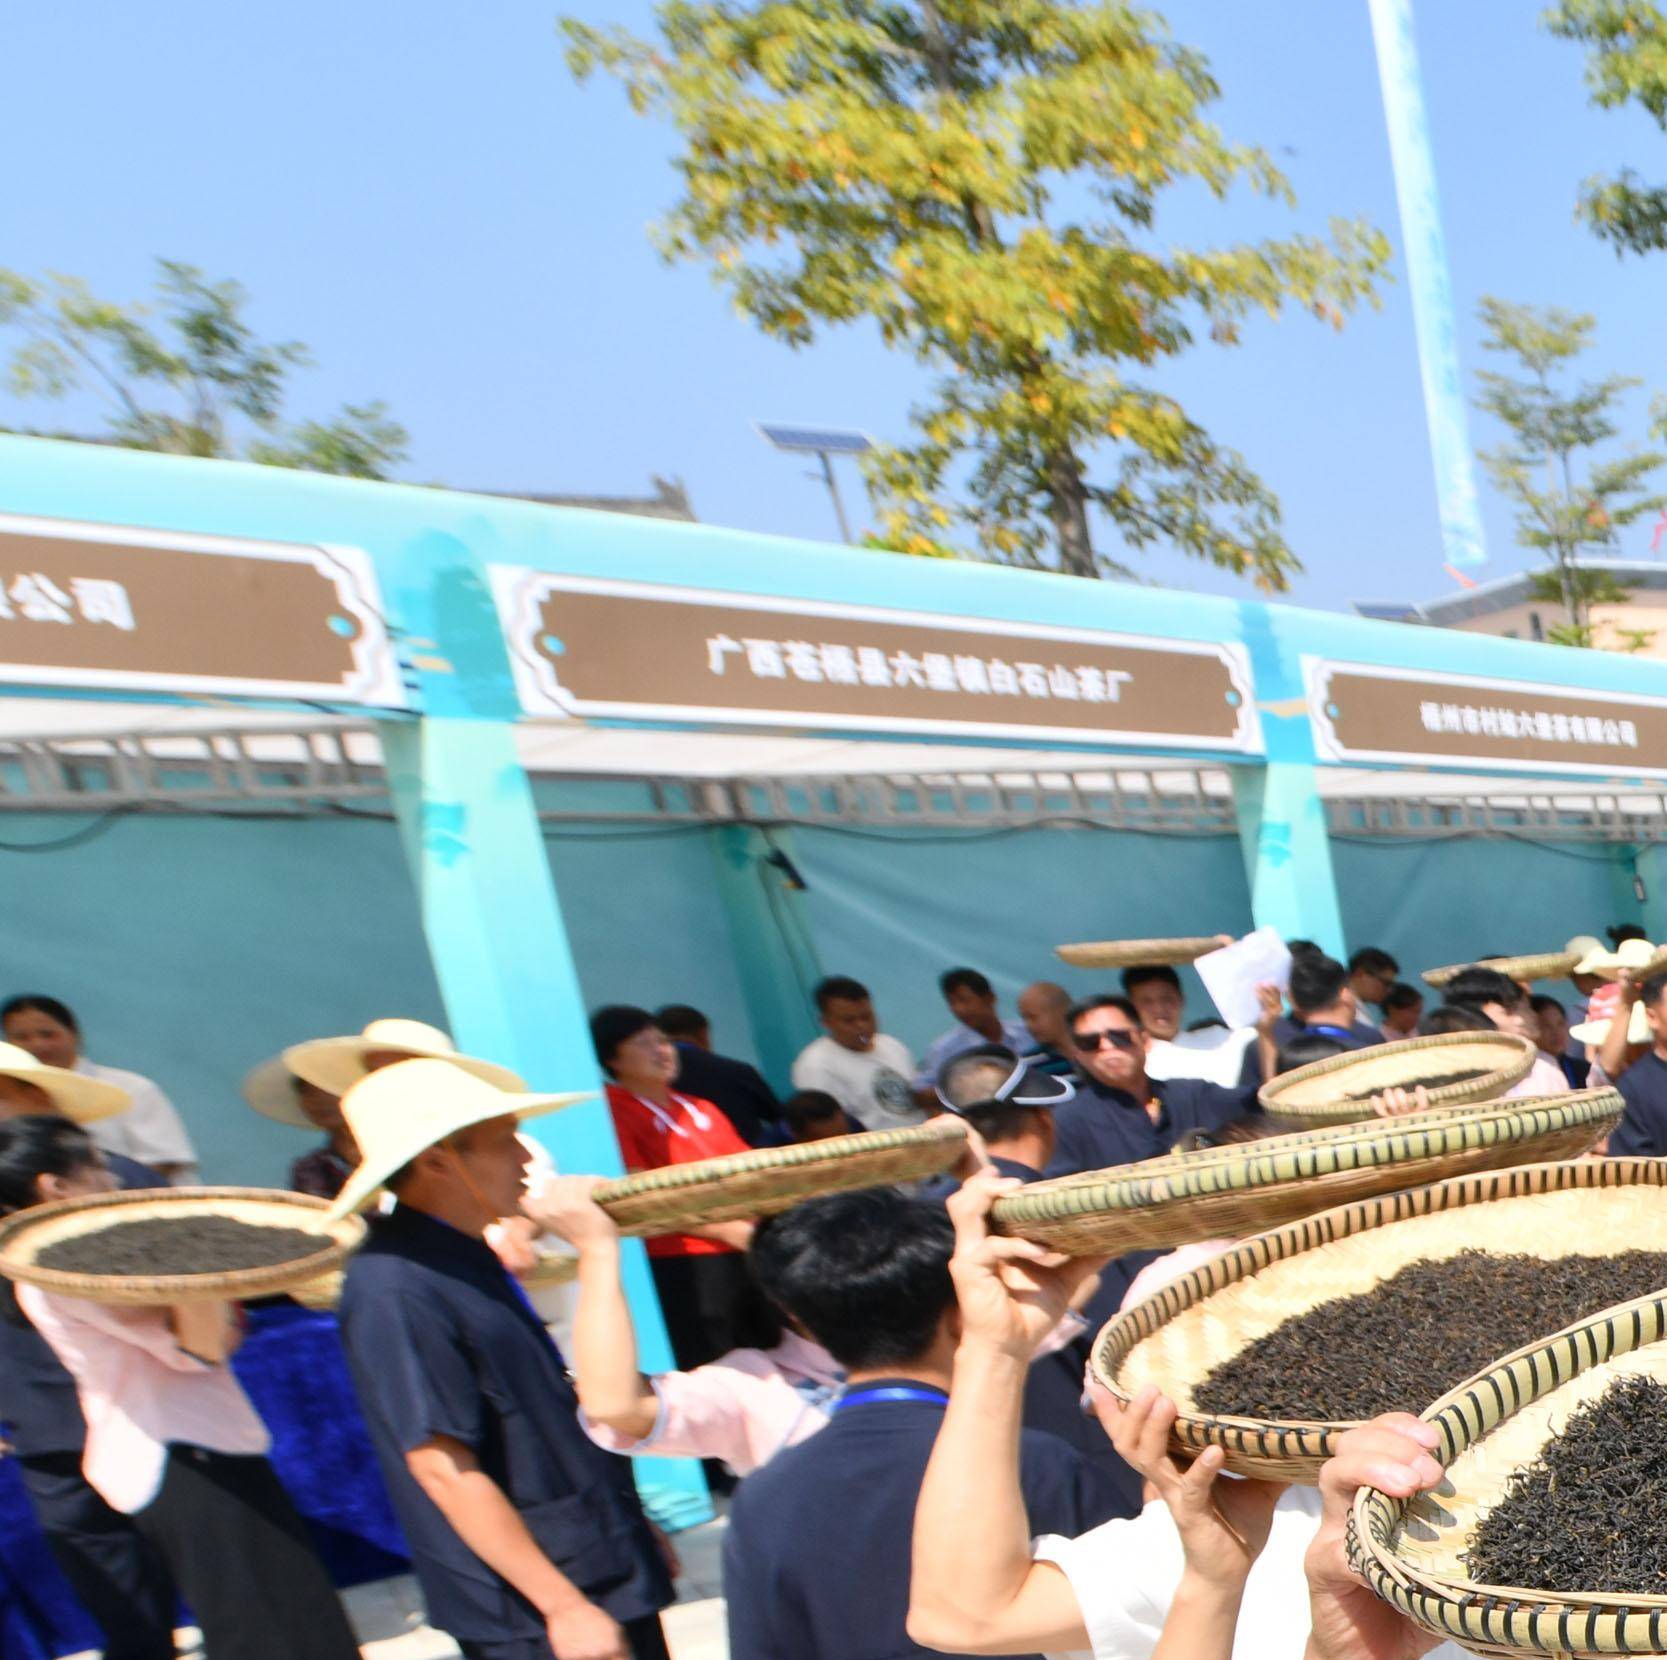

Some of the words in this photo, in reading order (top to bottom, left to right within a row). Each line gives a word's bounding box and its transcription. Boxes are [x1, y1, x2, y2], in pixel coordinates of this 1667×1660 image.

[705, 632, 1135, 704] 广西苍梧县六堡镇白石山茶厂
